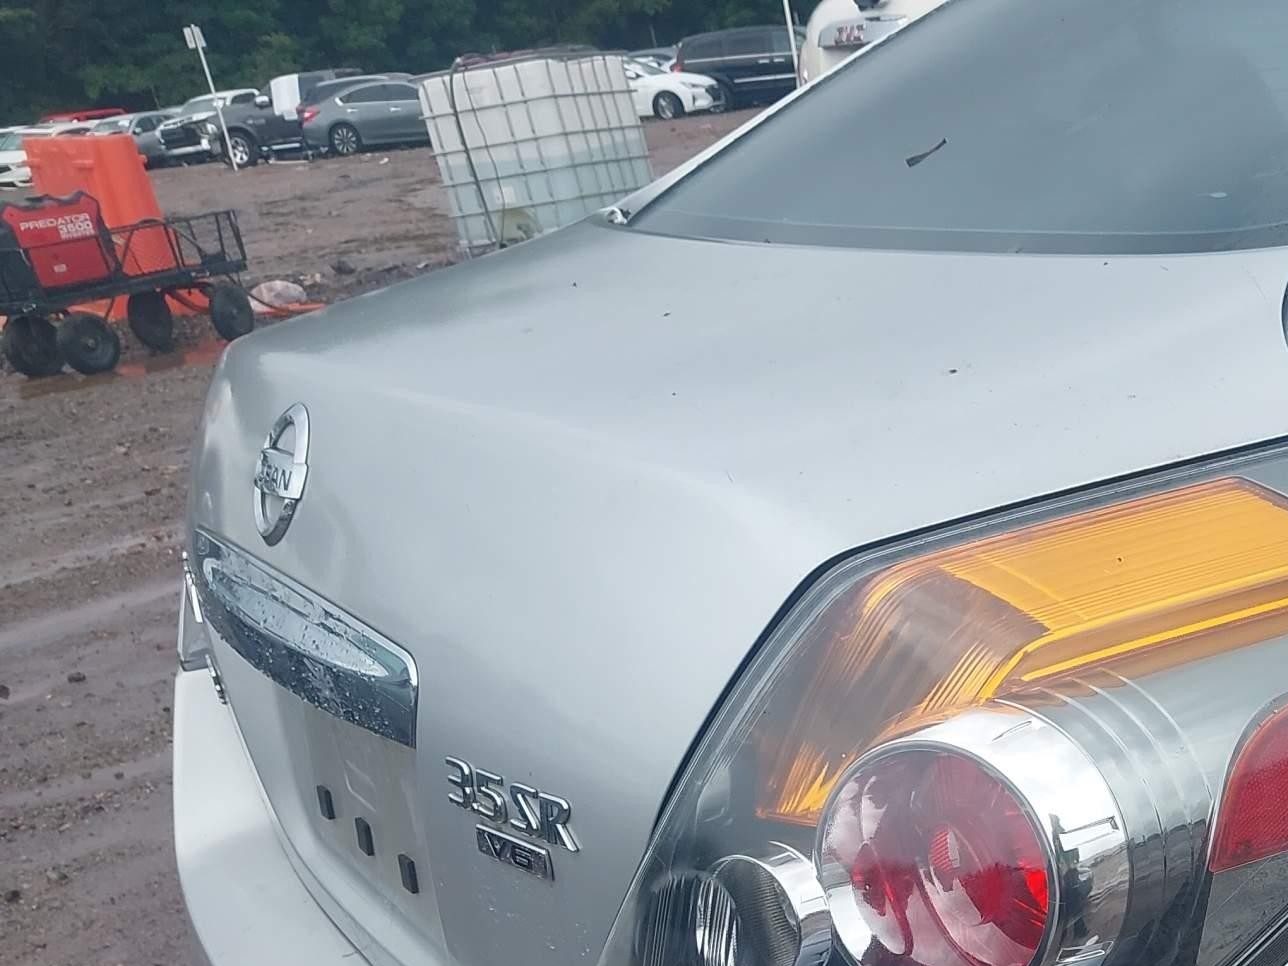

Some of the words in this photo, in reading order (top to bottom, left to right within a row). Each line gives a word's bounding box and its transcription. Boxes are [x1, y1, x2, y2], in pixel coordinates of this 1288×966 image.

[19, 213, 90, 231] PREDATOR
[57, 221, 93, 233] 3500
[510, 781, 580, 852] SR
